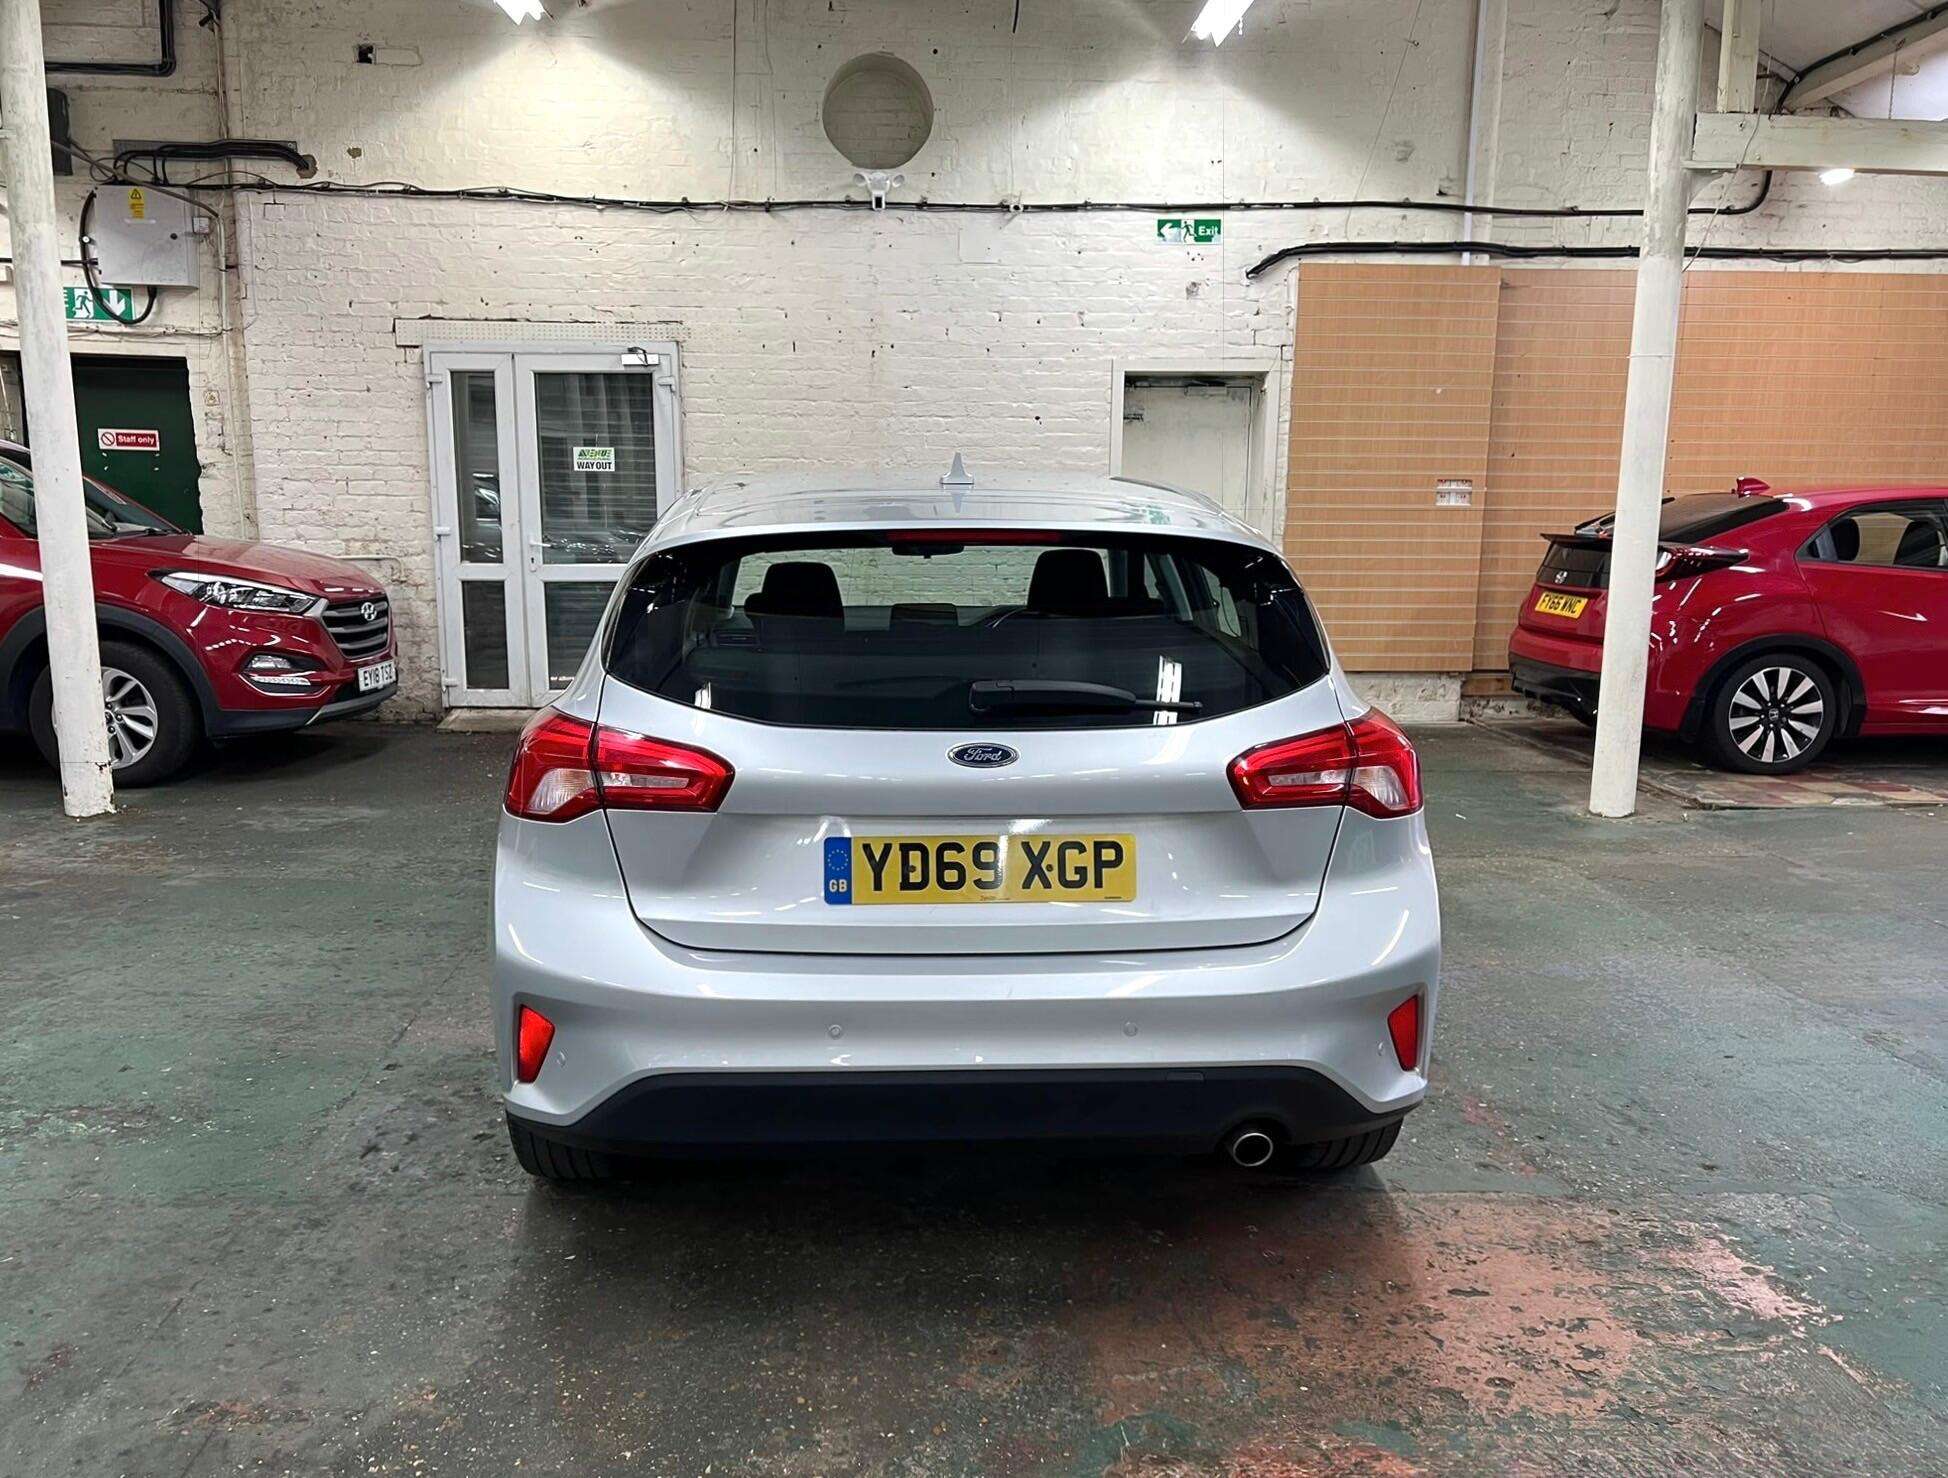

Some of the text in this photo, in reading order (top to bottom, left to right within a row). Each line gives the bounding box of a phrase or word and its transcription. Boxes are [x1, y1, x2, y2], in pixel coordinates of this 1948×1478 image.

[1198, 226, 1219, 236] Exit
[117, 435, 155, 445] Staff only
[576, 461, 612, 470] WAY OUT
[963, 747, 1002, 761] Ford
[861, 840, 1125, 892] YD69 XGP
[829, 879, 848, 893] GB
